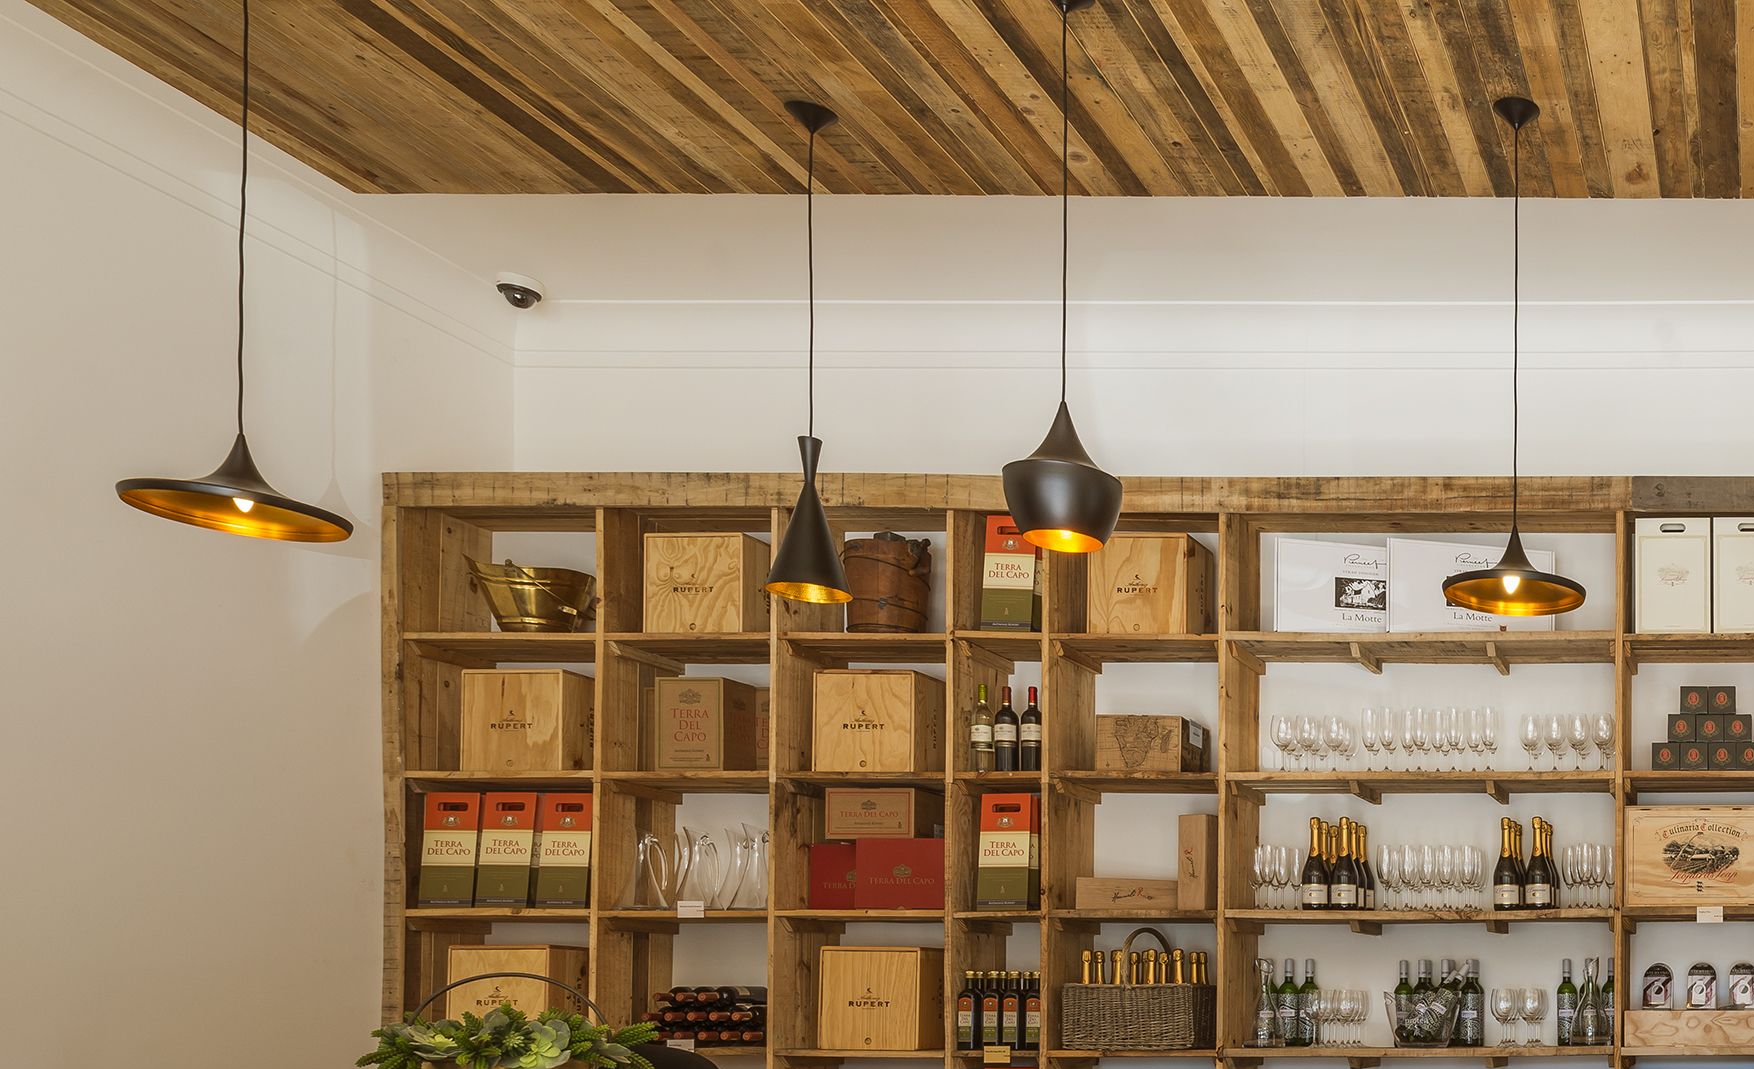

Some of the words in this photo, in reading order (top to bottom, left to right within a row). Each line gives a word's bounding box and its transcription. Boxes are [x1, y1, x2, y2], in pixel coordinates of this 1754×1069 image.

[995, 563, 1022, 571] TERRA
[1006, 571, 1030, 579] CAPO
[1342, 613, 1353, 622] La
[1355, 613, 1382, 623] Motte
[1453, 612, 1464, 620] La
[1466, 612, 1493, 622] Motte
[672, 708, 709, 719] TERRA
[679, 719, 701, 730] DEL
[673, 731, 707, 743] CAPO
[864, 810, 878, 818] DEL
[1662, 824, 1700, 838] Culinaria
[1700, 822, 1741, 838] Collection
[434, 840, 463, 848] TERRA
[492, 839, 519, 847] TERRA
[552, 840, 577, 848] TERRA
[427, 848, 446, 856] DEL
[447, 848, 471, 856] CAPO
[485, 847, 503, 855] DEL
[504, 847, 527, 855] CAPO
[545, 848, 562, 856] DEL
[1001, 849, 1025, 857] CAPO
[912, 877, 935, 885] CAPO
